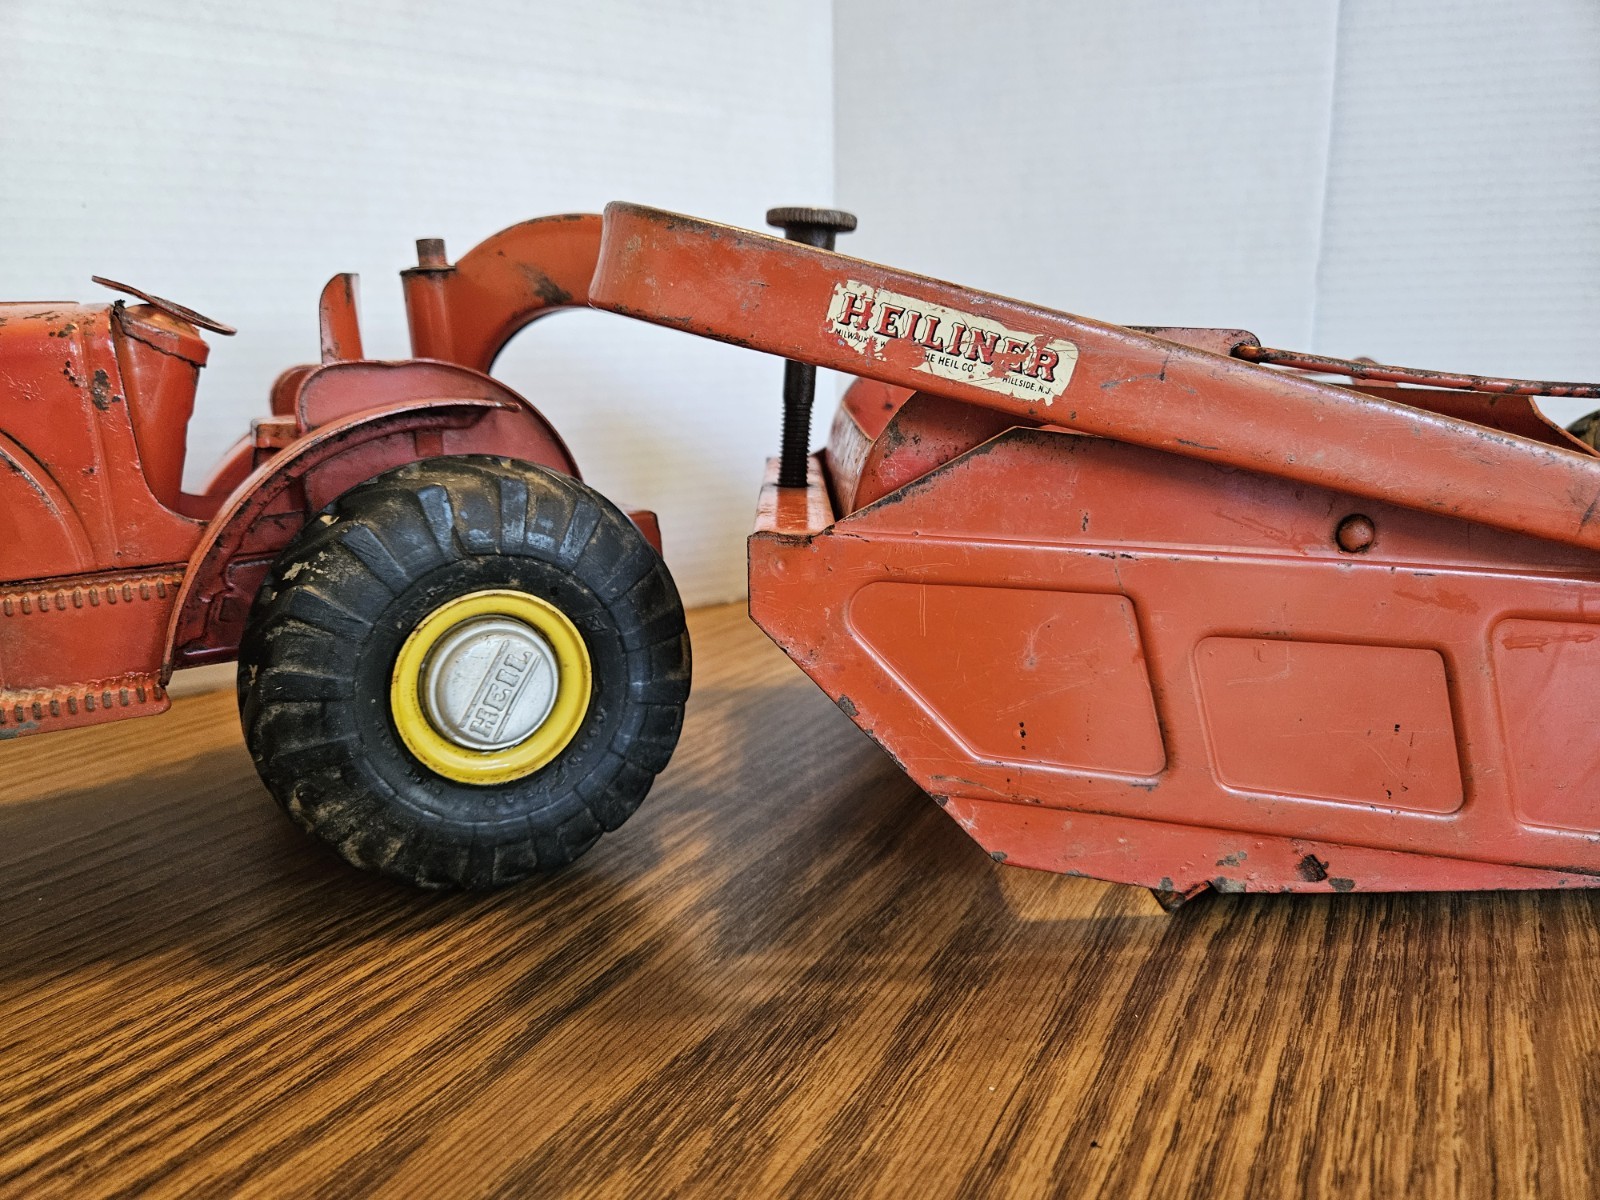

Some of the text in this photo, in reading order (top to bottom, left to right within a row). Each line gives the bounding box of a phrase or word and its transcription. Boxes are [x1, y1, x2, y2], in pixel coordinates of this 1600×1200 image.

[837, 292, 1059, 382] HEILINER
[938, 356, 959, 369] HEIL
[469, 651, 533, 738] HEIL
